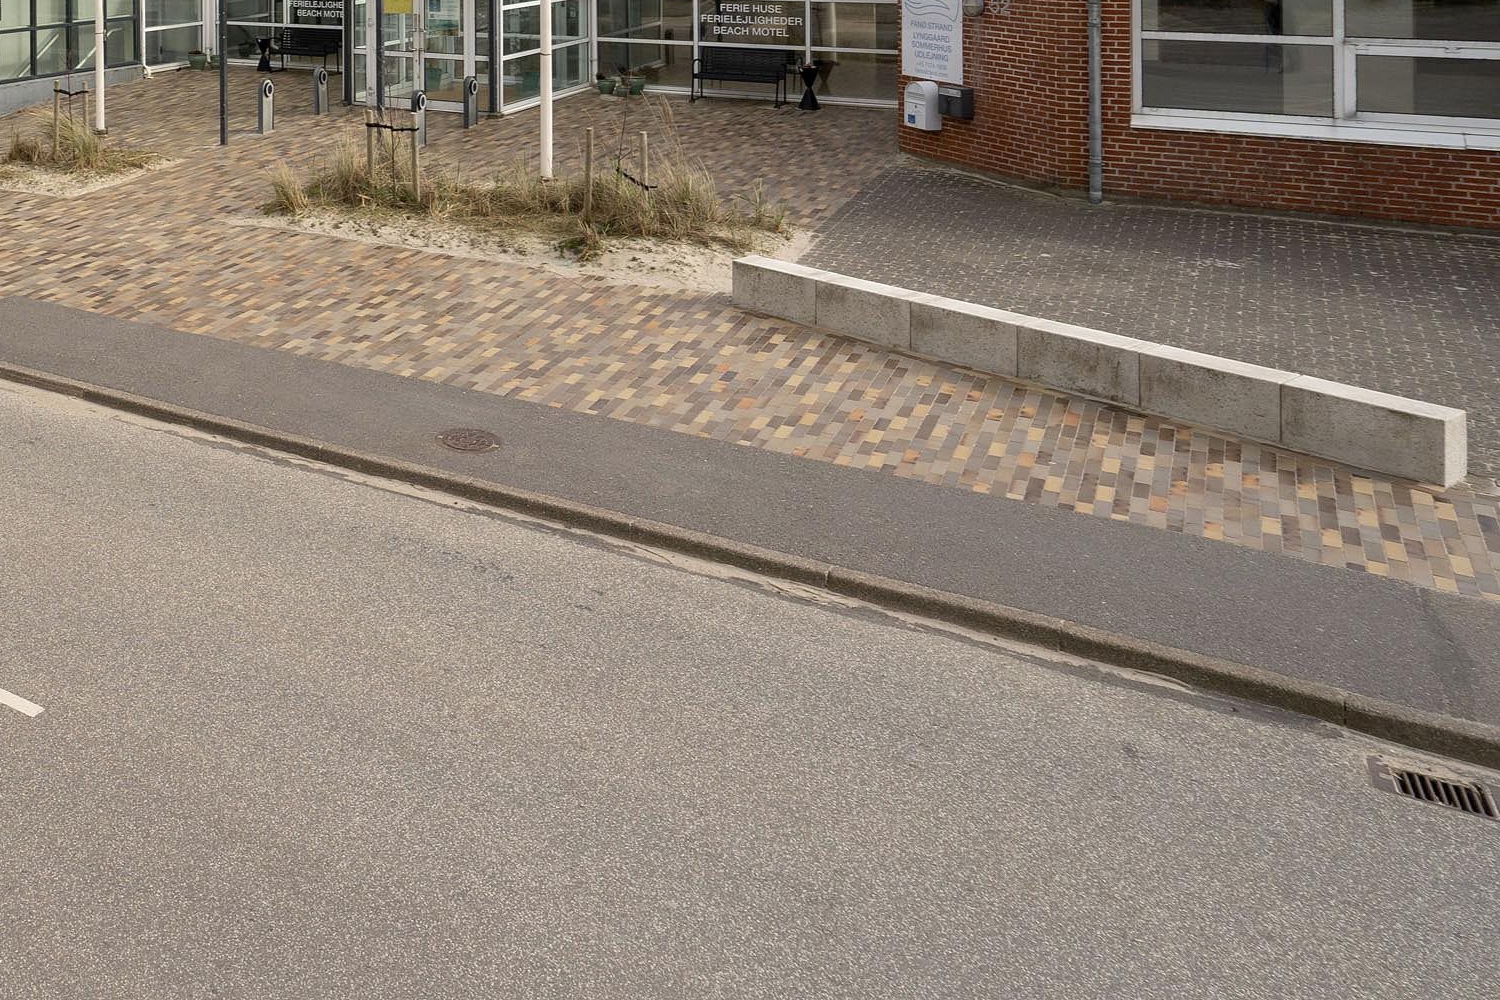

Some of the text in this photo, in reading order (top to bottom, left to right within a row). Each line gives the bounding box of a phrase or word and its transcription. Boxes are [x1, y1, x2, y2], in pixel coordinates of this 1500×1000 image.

[297, 9, 322, 17] BEACH
[720, 3, 782, 14] FERIE HUSE
[701, 14, 803, 26] FERIELEJLIGHEDER
[713, 26, 789, 37] BEACH MOTEL
[928, 22, 953, 32] STRAND
